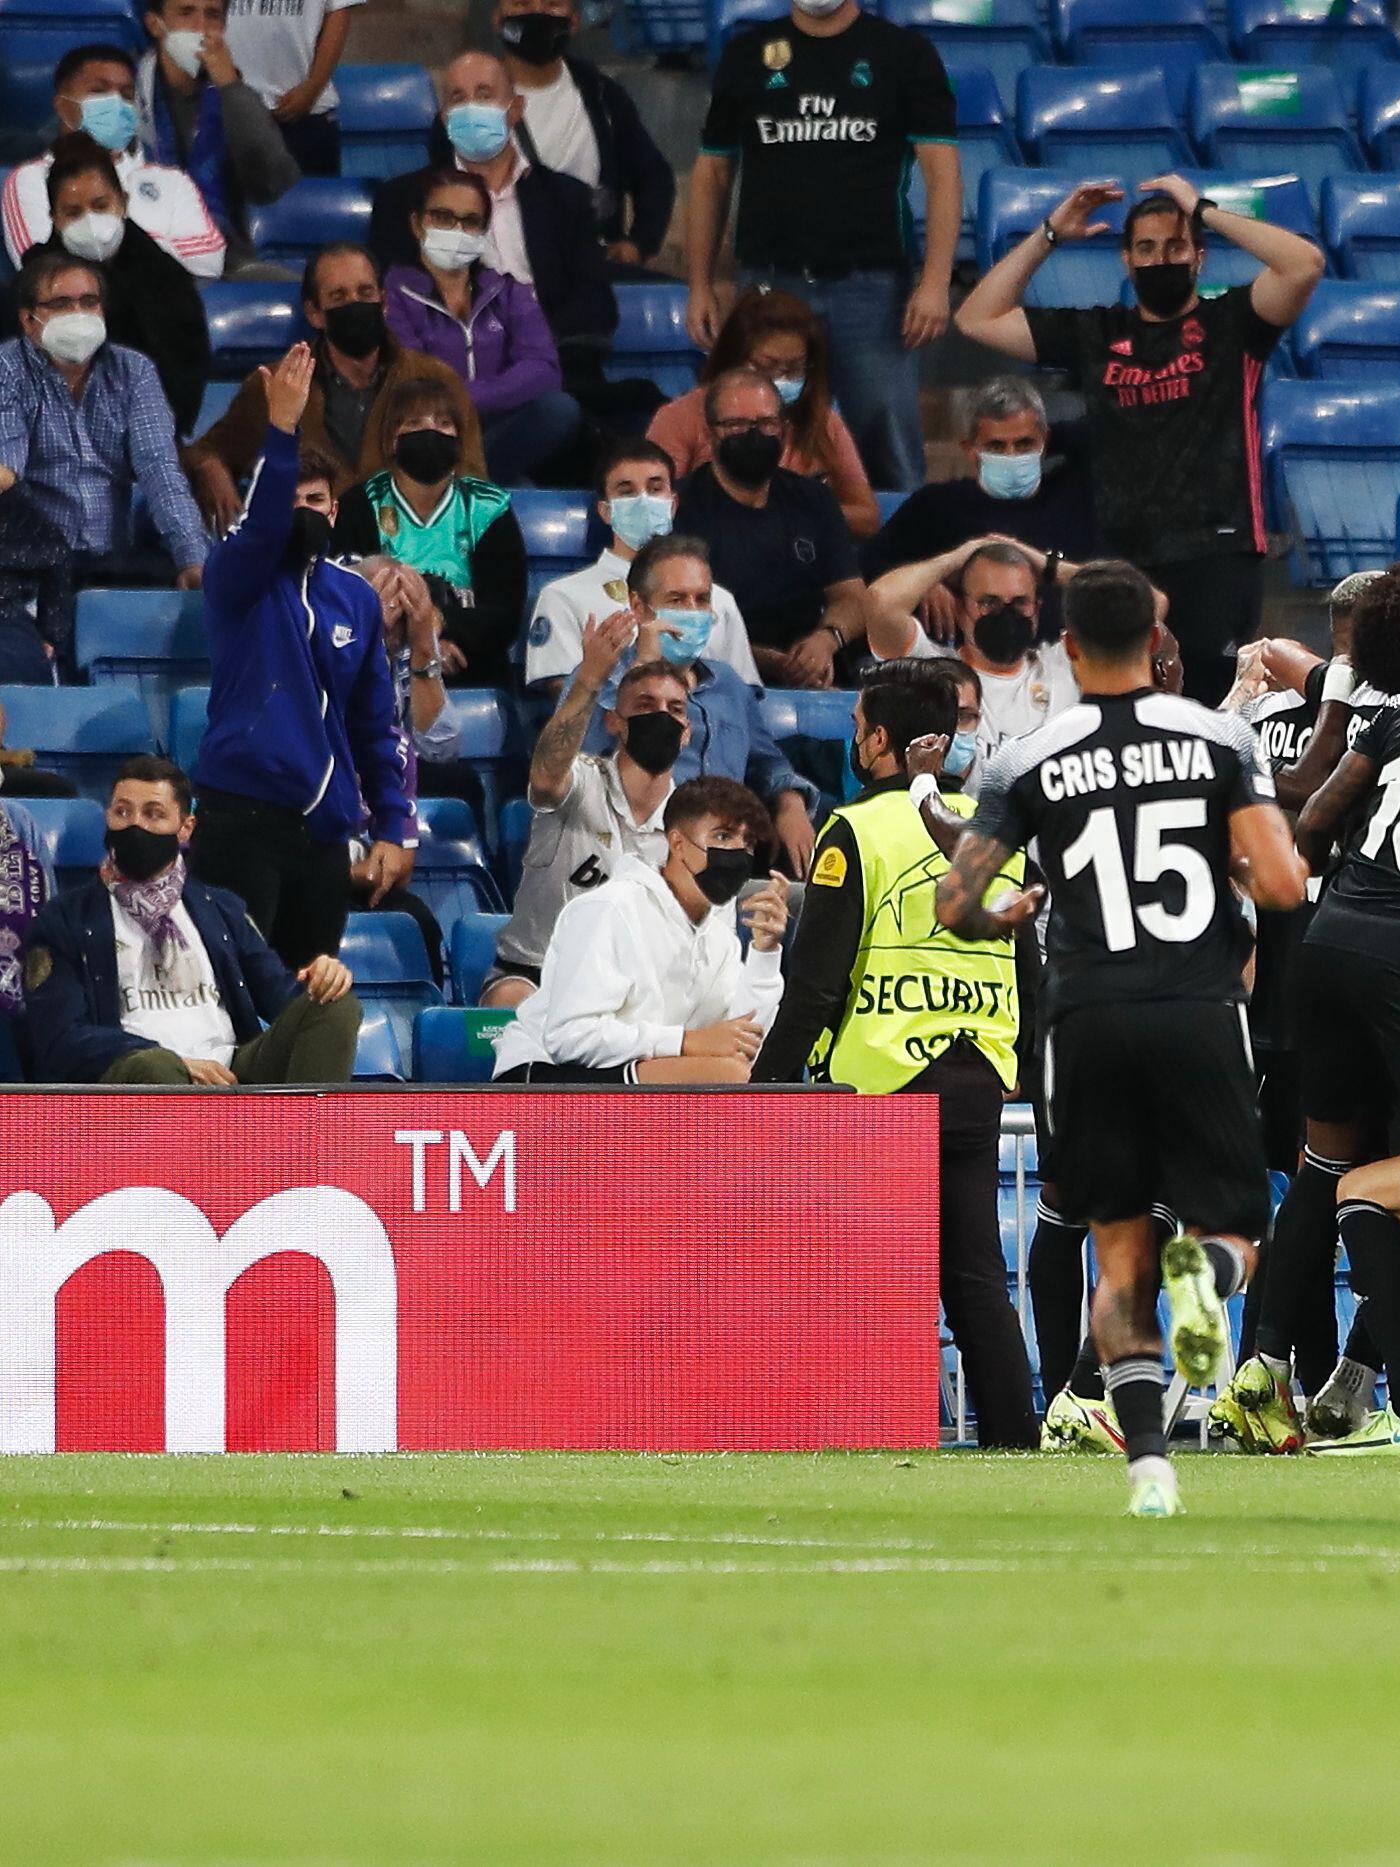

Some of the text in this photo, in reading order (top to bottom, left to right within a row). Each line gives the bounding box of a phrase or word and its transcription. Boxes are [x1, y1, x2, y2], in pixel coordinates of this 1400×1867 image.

[757, 113, 878, 144] Emirates
[799, 95, 836, 117] Fly
[1040, 738, 1216, 802] CRIS SILVA
[1062, 797, 1216, 952] 15
[393, 1129, 518, 1212] TM
